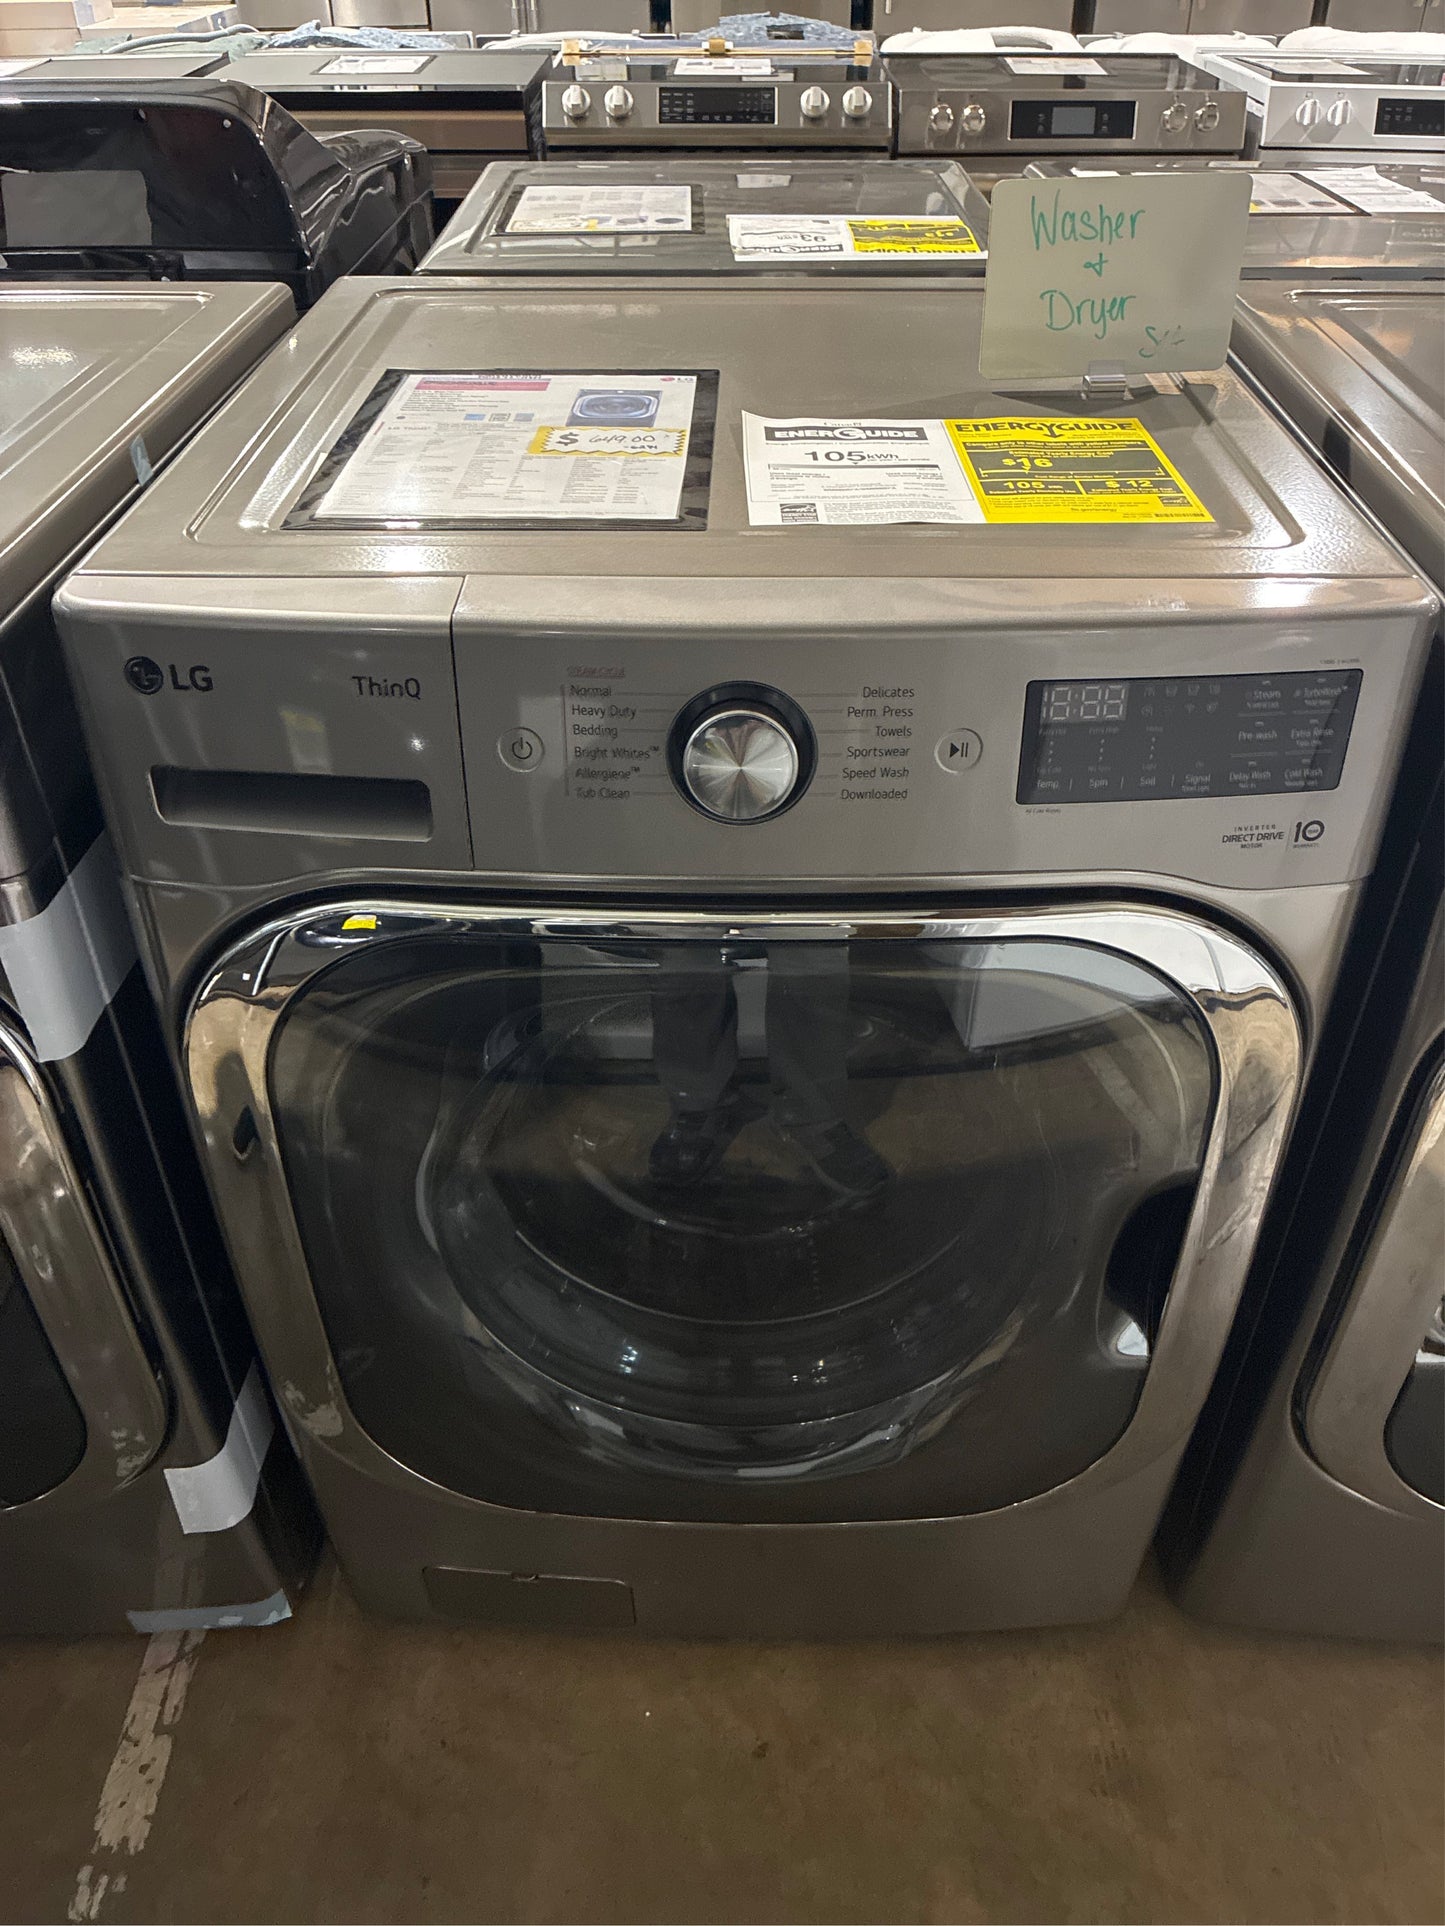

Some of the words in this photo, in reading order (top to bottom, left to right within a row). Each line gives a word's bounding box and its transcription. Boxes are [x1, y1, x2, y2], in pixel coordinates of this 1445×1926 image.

[1030, 188, 1146, 250] Washer
[1039, 289, 1137, 340] Dryer
[773, 427, 920, 440] ENERGUIDE
[954, 422, 1137, 437] ENERGYGUIDE
[556, 432, 579, 446] $
[804, 450, 866, 462] 105
[1002, 458, 1053, 468] $16
[168, 664, 214, 692] LG
[352, 676, 422, 700] ThinQ
[569, 684, 612, 697] Normal
[862, 686, 915, 698] Delicates
[572, 704, 606, 719] Heavy
[608, 705, 636, 720] Duty
[882, 705, 914, 717] Press
[573, 724, 618, 740] Bedding
[876, 725, 912, 737] Towels
[574, 746, 608, 760] Bright
[847, 746, 911, 760] Sportswear
[842, 767, 877, 781] Speed
[880, 767, 910, 778] Wash
[1185, 774, 1212, 784] Signal
[1089, 778, 1109, 788] Spin
[1140, 776, 1156, 786] Soil
[576, 787, 597, 798] Tub
[600, 787, 630, 798] Clean
[841, 788, 908, 800] Downloaded
[1234, 824, 1276, 833] INVERTER
[1294, 820, 1325, 842] 10
[1222, 834, 1256, 844] DIRECT
[1256, 832, 1285, 842] DRIVE
